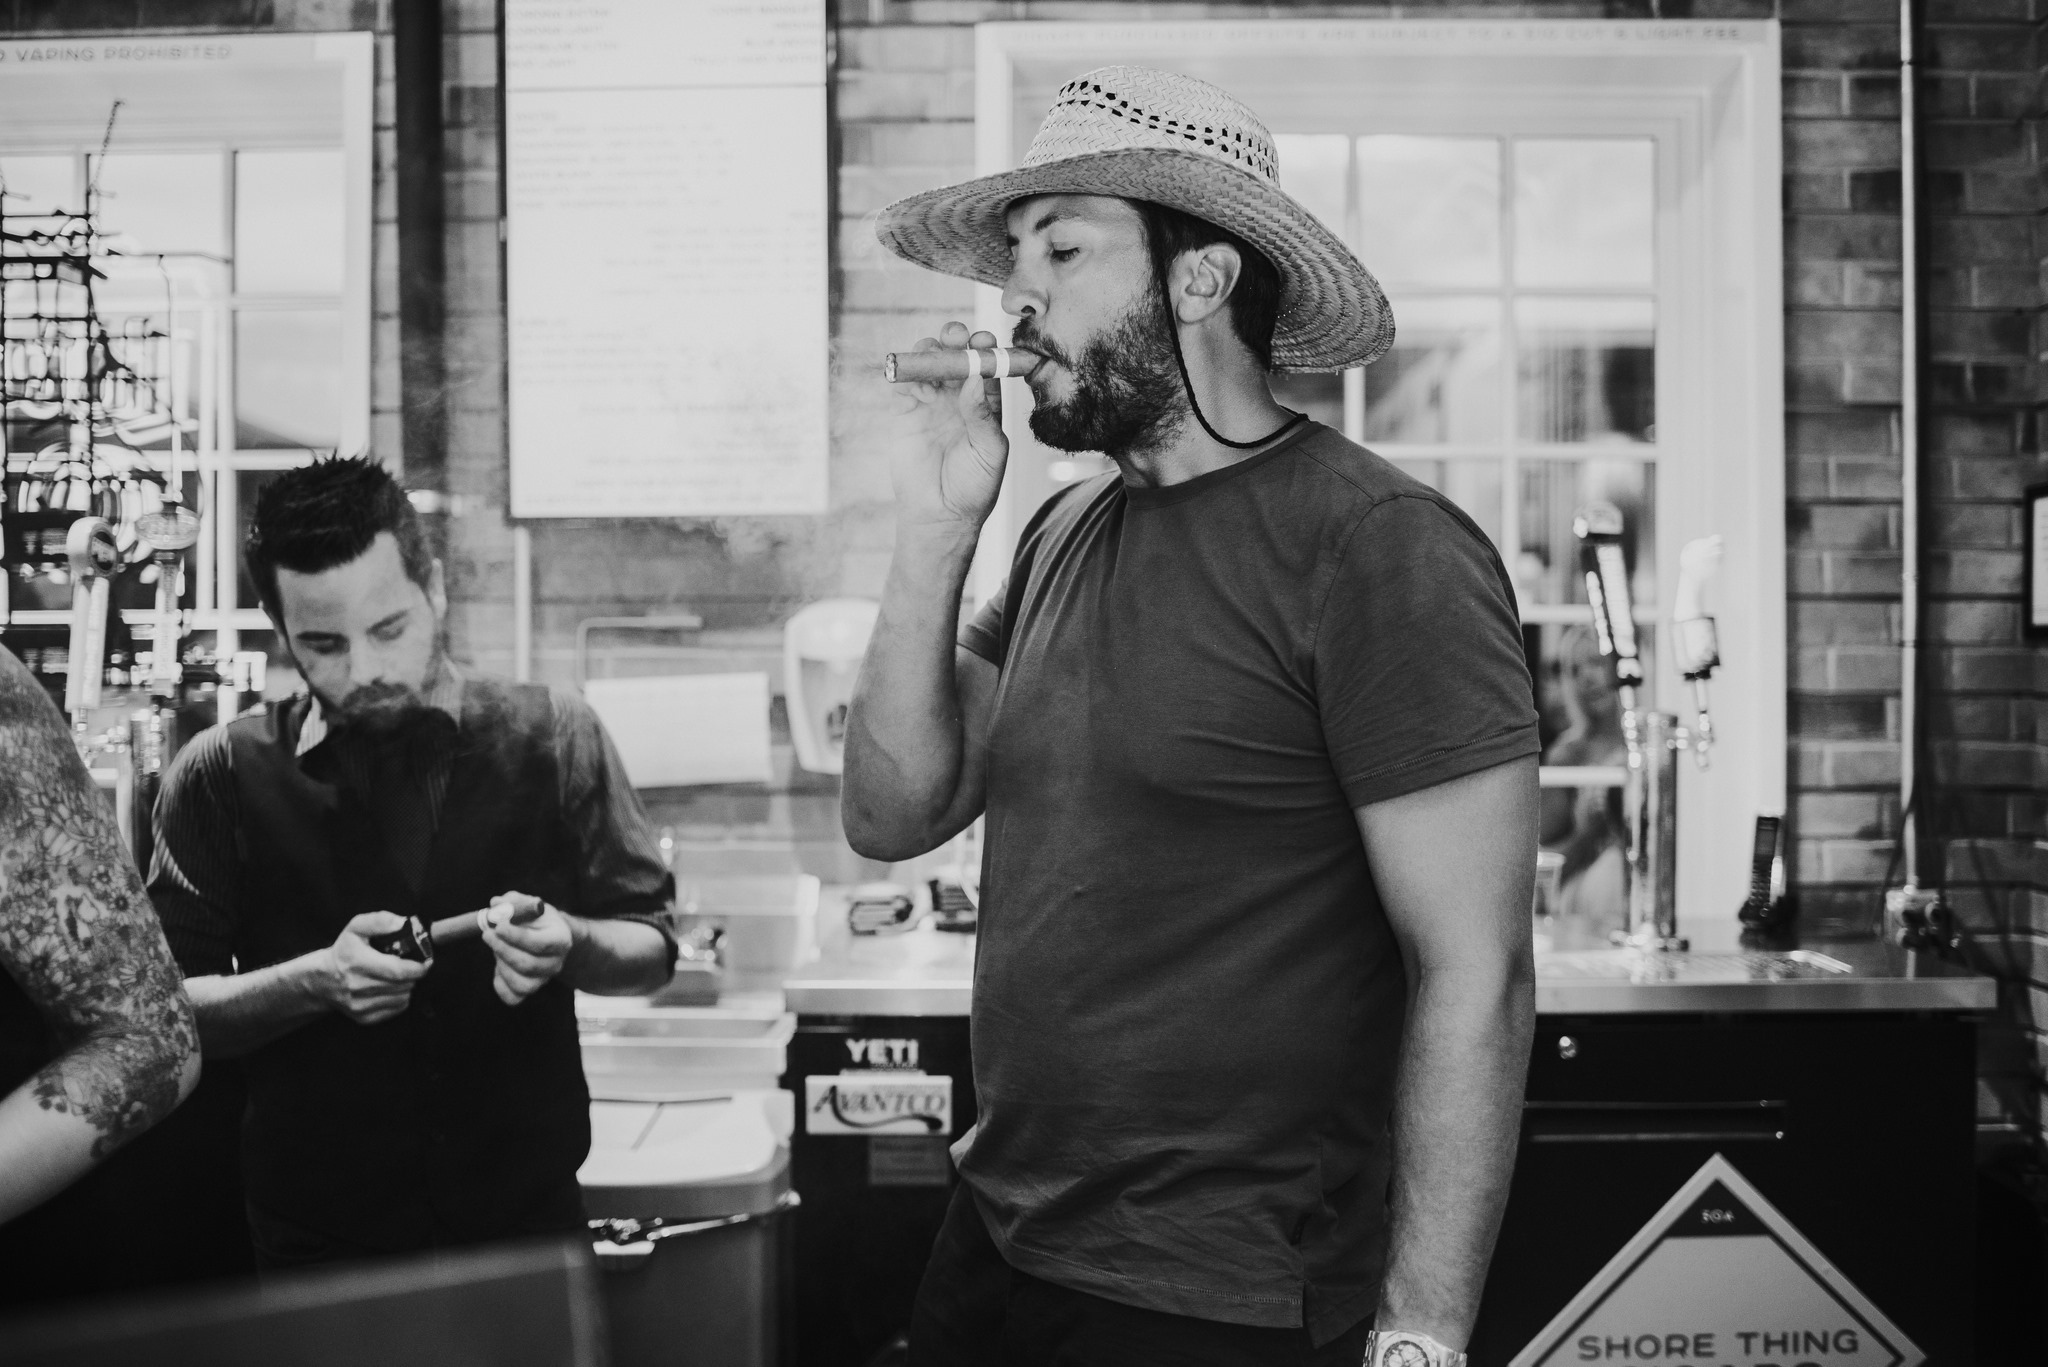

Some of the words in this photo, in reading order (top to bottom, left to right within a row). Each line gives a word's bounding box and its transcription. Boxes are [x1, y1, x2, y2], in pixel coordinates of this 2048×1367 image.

[1635, 26, 1693, 40] LIGHT
[1702, 25, 1740, 40] FEE
[15, 46, 96, 63] VAPING
[103, 45, 233, 61] PROHIBITED
[845, 1038, 919, 1066] YETI
[1577, 1332, 1716, 1361] SHORE
[1735, 1328, 1860, 1356] THING
